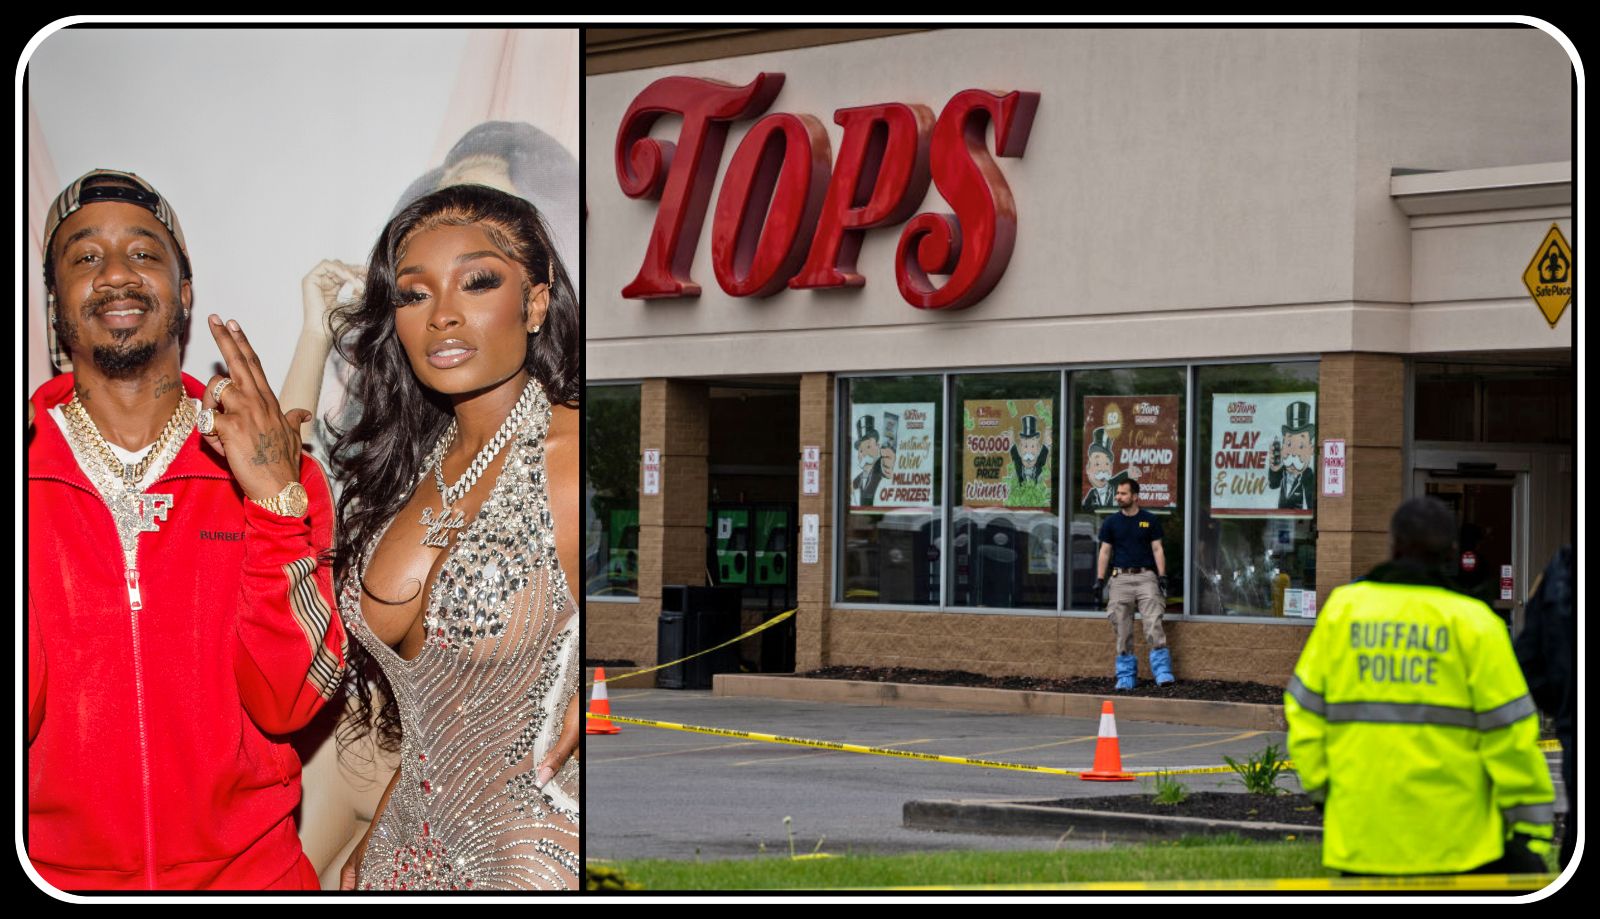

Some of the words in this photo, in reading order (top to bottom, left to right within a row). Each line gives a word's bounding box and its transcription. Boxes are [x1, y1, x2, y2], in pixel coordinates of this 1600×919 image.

[615, 72, 1041, 310] TOPS
[967, 435, 1009, 454] $60,000
[1223, 431, 1261, 449] PLAY
[1120, 449, 1173, 464] DIAMOND
[1329, 444, 1339, 455] NO
[974, 456, 1003, 467] GRAND
[1215, 451, 1267, 469] ONLINE
[892, 472, 931, 485] MILLIONS
[976, 468, 1000, 479] PRIZE
[1214, 471, 1228, 496] &
[880, 488, 895, 501] OF
[1350, 621, 1450, 654] BUFFALO
[1357, 653, 1440, 686] POLICE
